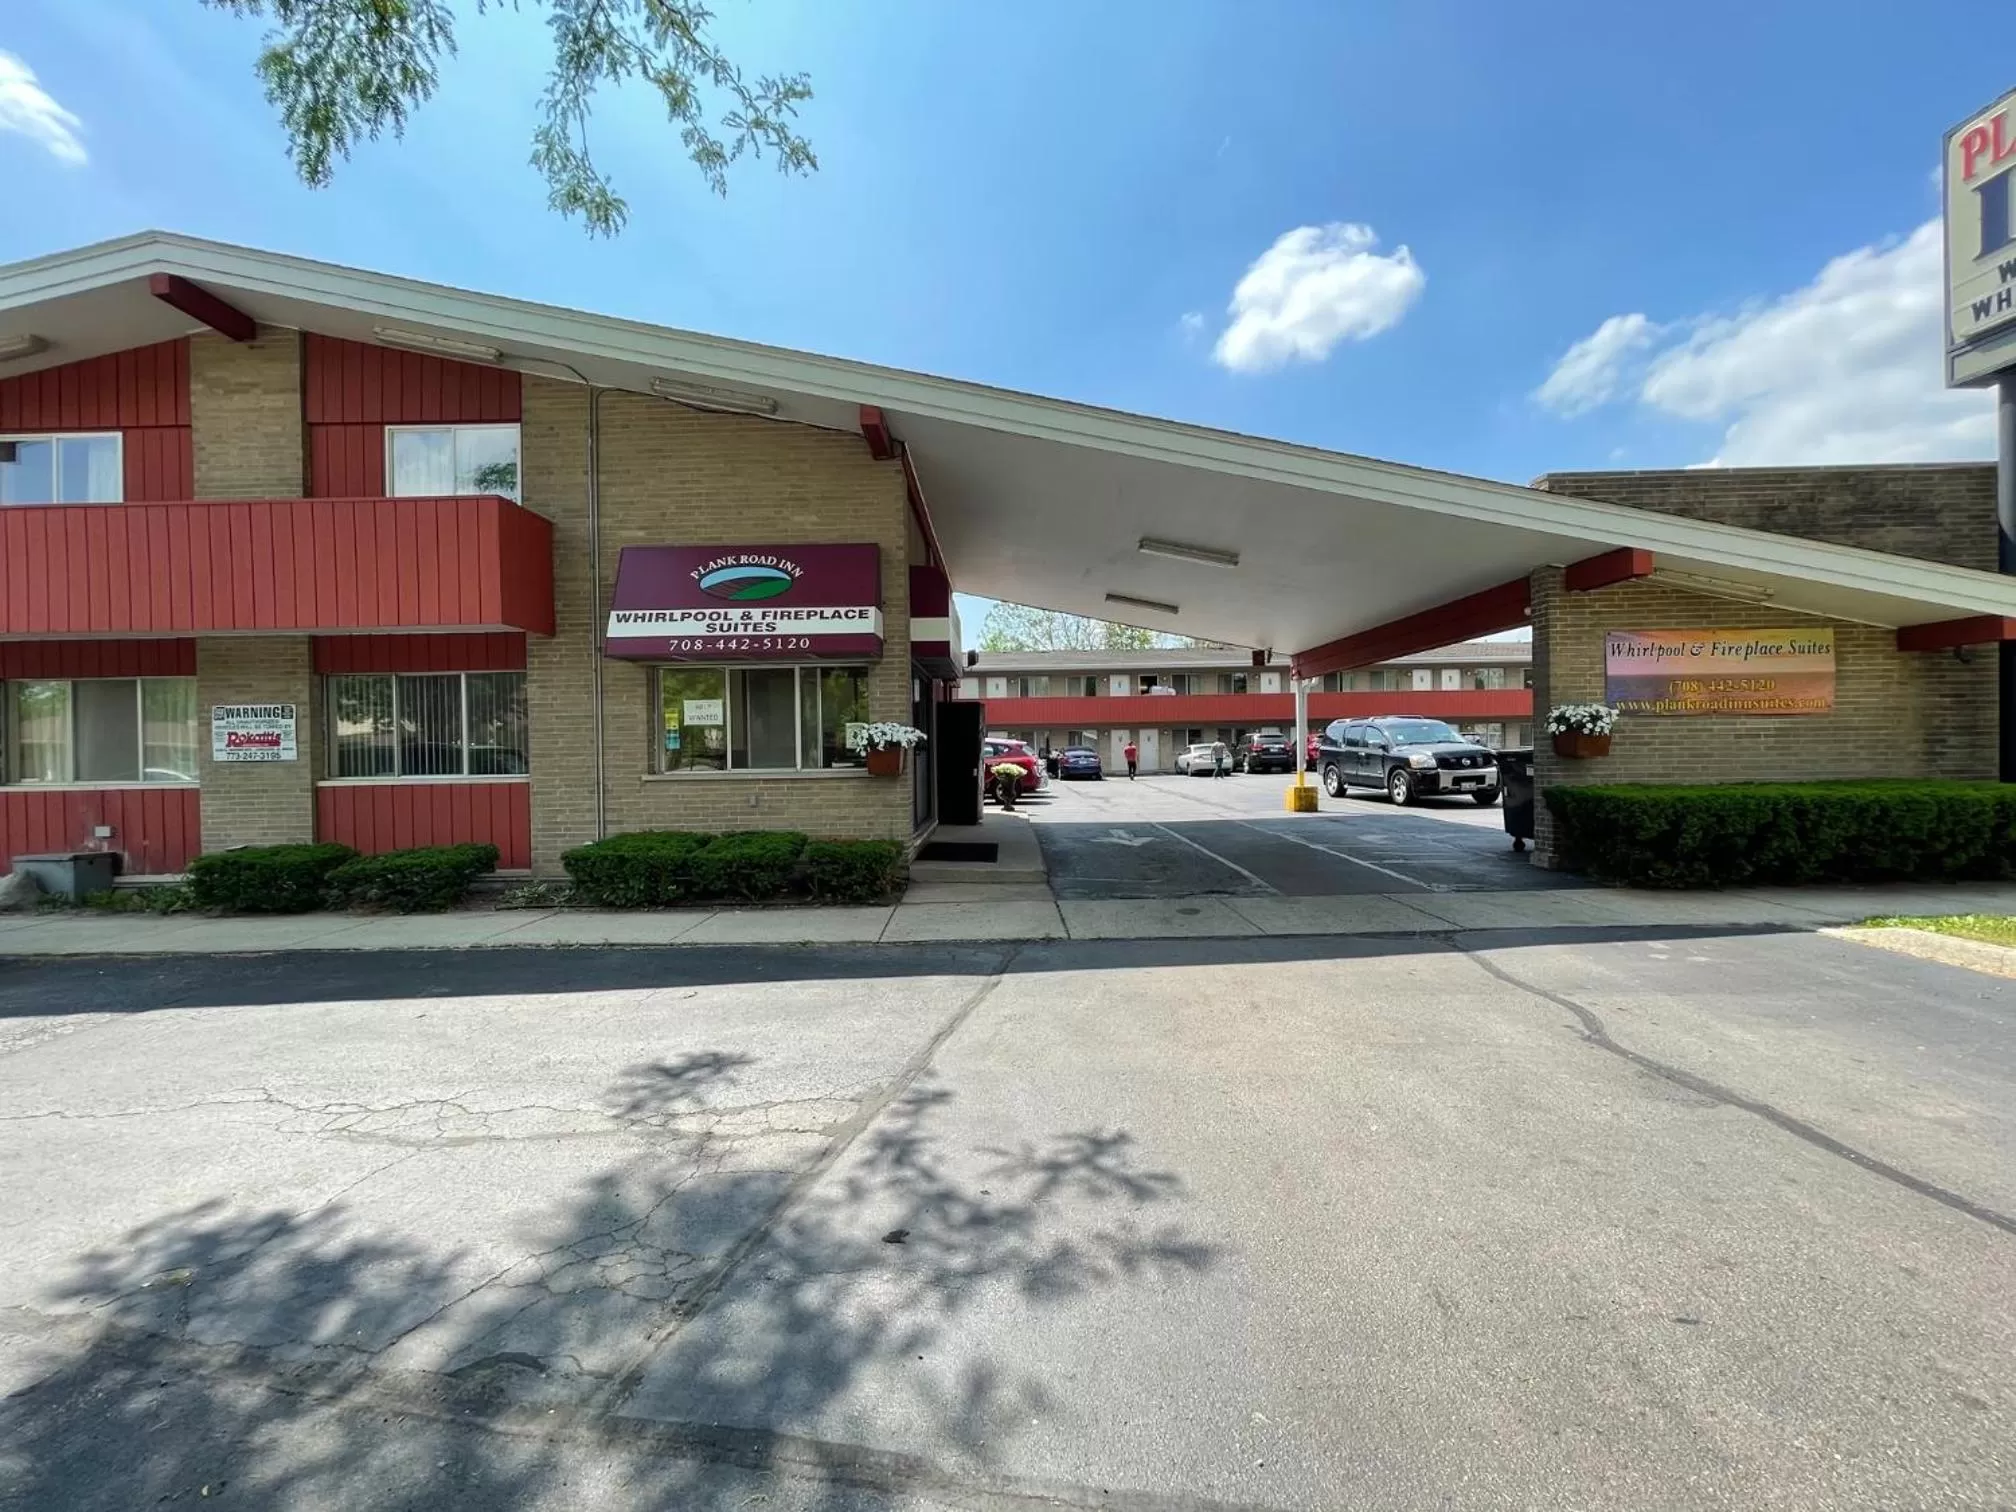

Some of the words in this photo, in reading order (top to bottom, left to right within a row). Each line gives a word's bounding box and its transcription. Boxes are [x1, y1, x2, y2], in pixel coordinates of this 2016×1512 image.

[690, 555, 737, 579] PLANK
[740, 554, 778, 566] ROAD
[779, 558, 804, 579] INN
[615, 611, 733, 624] WHIRLPOOL
[740, 610, 753, 622] &
[761, 609, 870, 621] FIREPLACE
[705, 622, 777, 634] SUITES
[669, 637, 811, 651] 708-442-5120
[1610, 642, 1685, 662] Whirlpool
[1690, 643, 1704, 657] &
[1710, 641, 1783, 661] Fireplace
[1787, 639, 1831, 655] Suites
[1668, 679, 1703, 696] (708)
[1708, 678, 1776, 694] 442-5120
[225, 706, 280, 719] WARNING
[688, 713, 719, 721] WANTED
